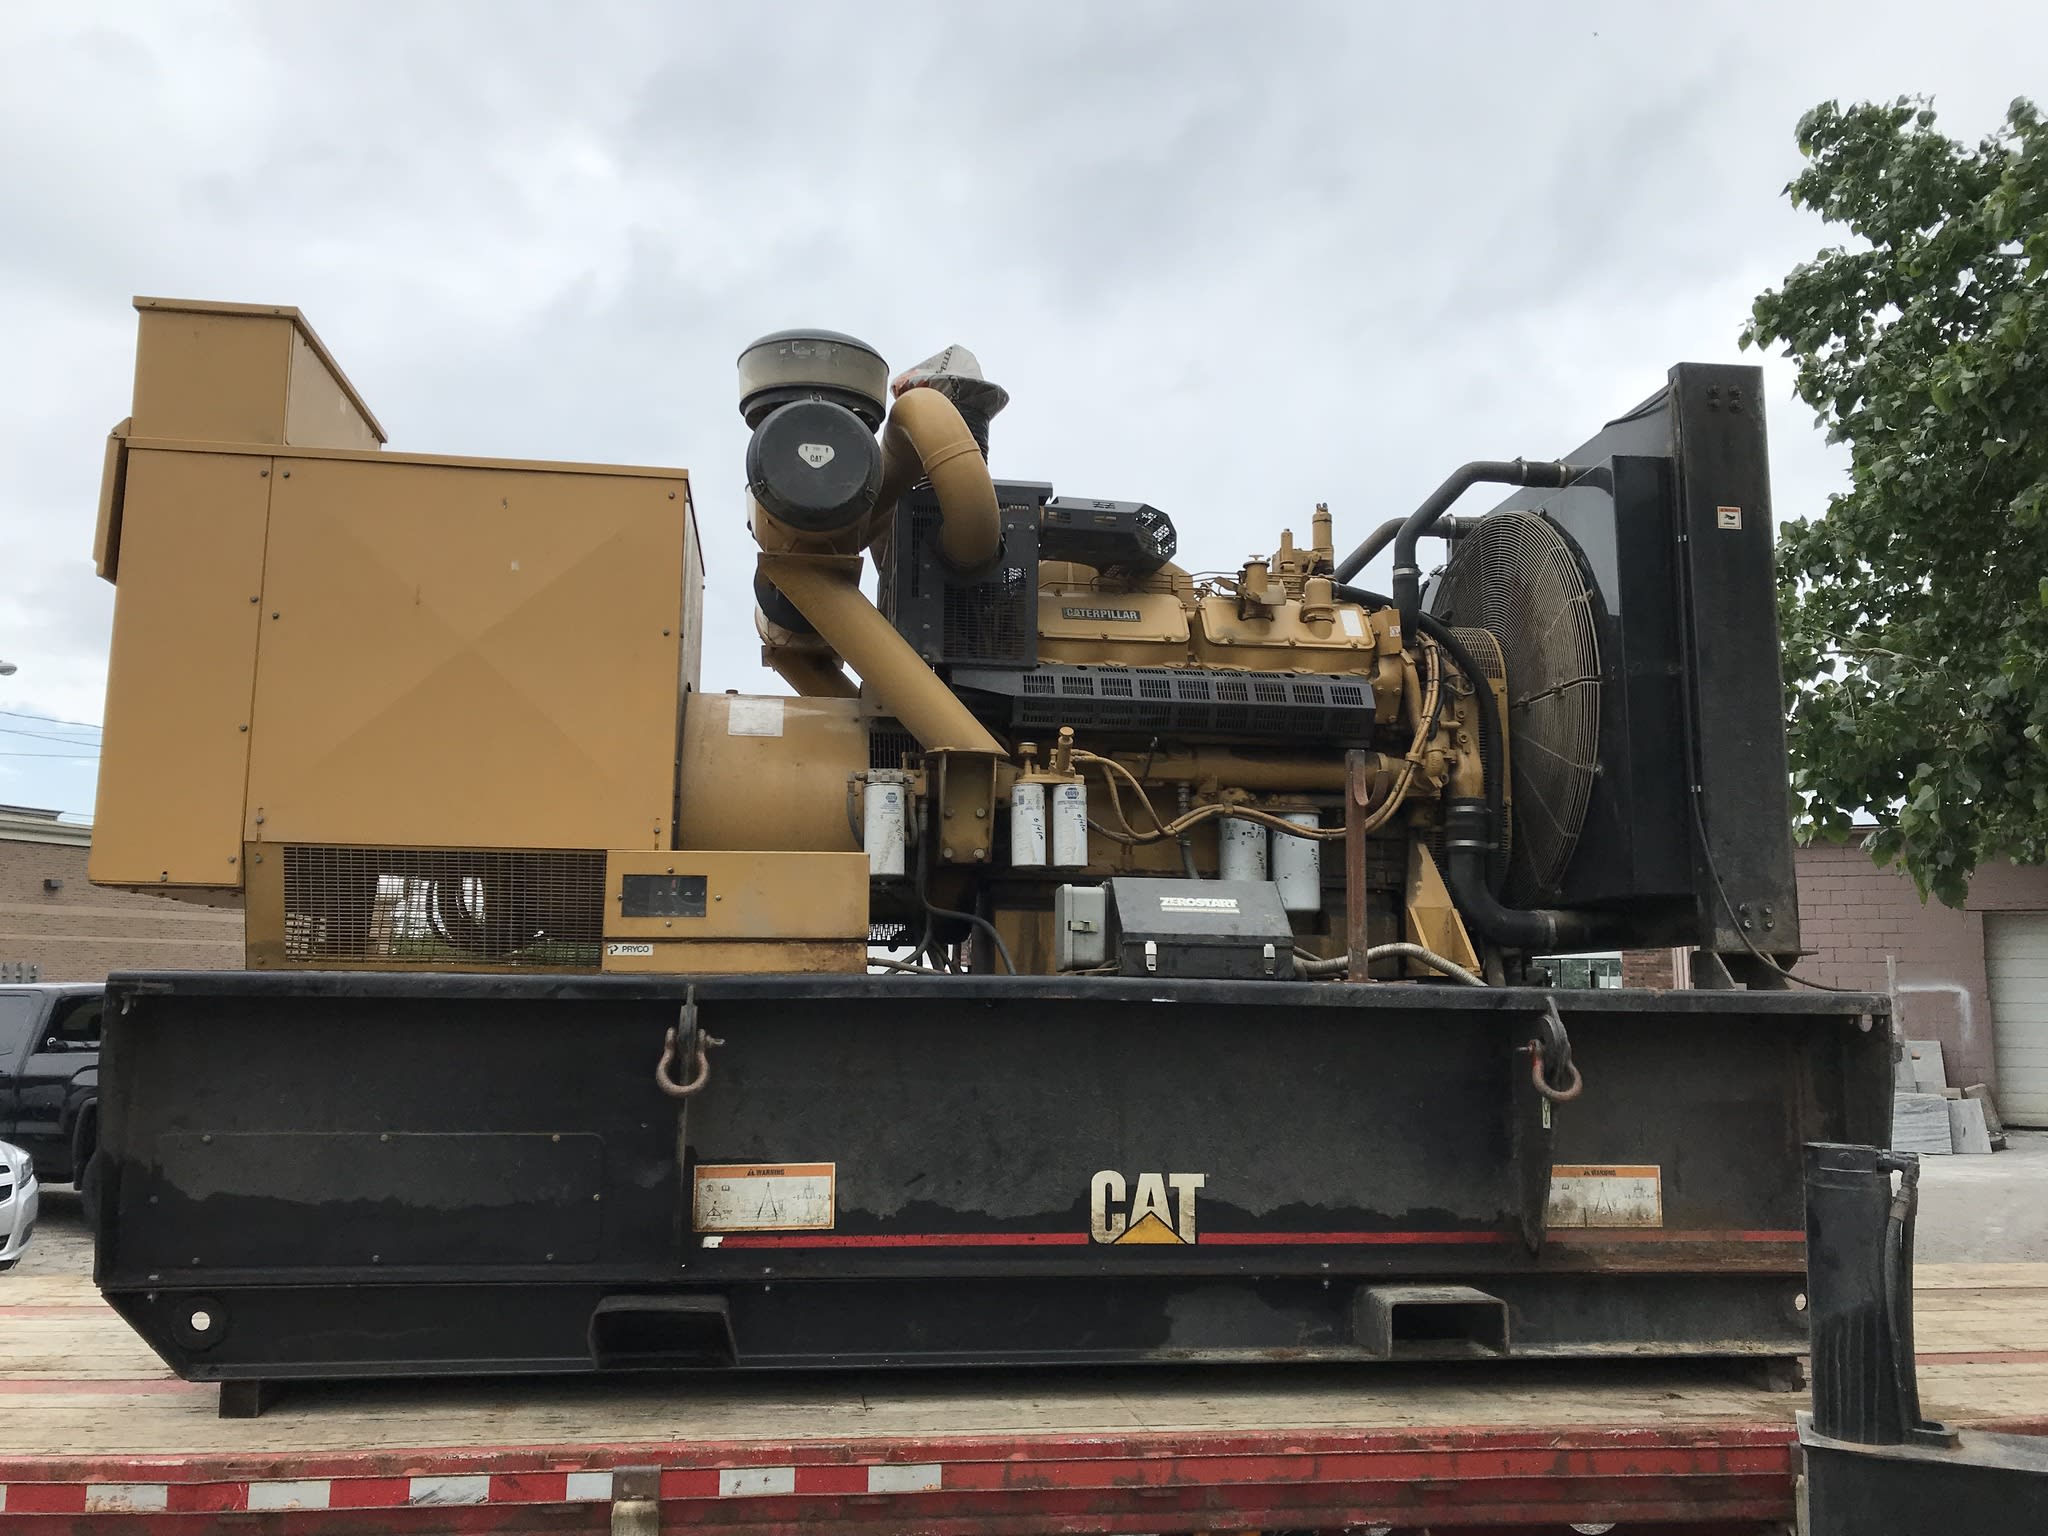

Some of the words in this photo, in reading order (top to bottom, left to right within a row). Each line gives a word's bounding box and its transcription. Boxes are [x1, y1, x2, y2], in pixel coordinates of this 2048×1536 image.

[810, 455, 822, 463] CAT
[1066, 608, 1138, 620] CATERPILLAR
[1159, 897, 1239, 908] ZEROSTART
[621, 945, 650, 953] PRYCO
[756, 1168, 785, 1176] WARNING
[1091, 1169, 1205, 1244] CAT
